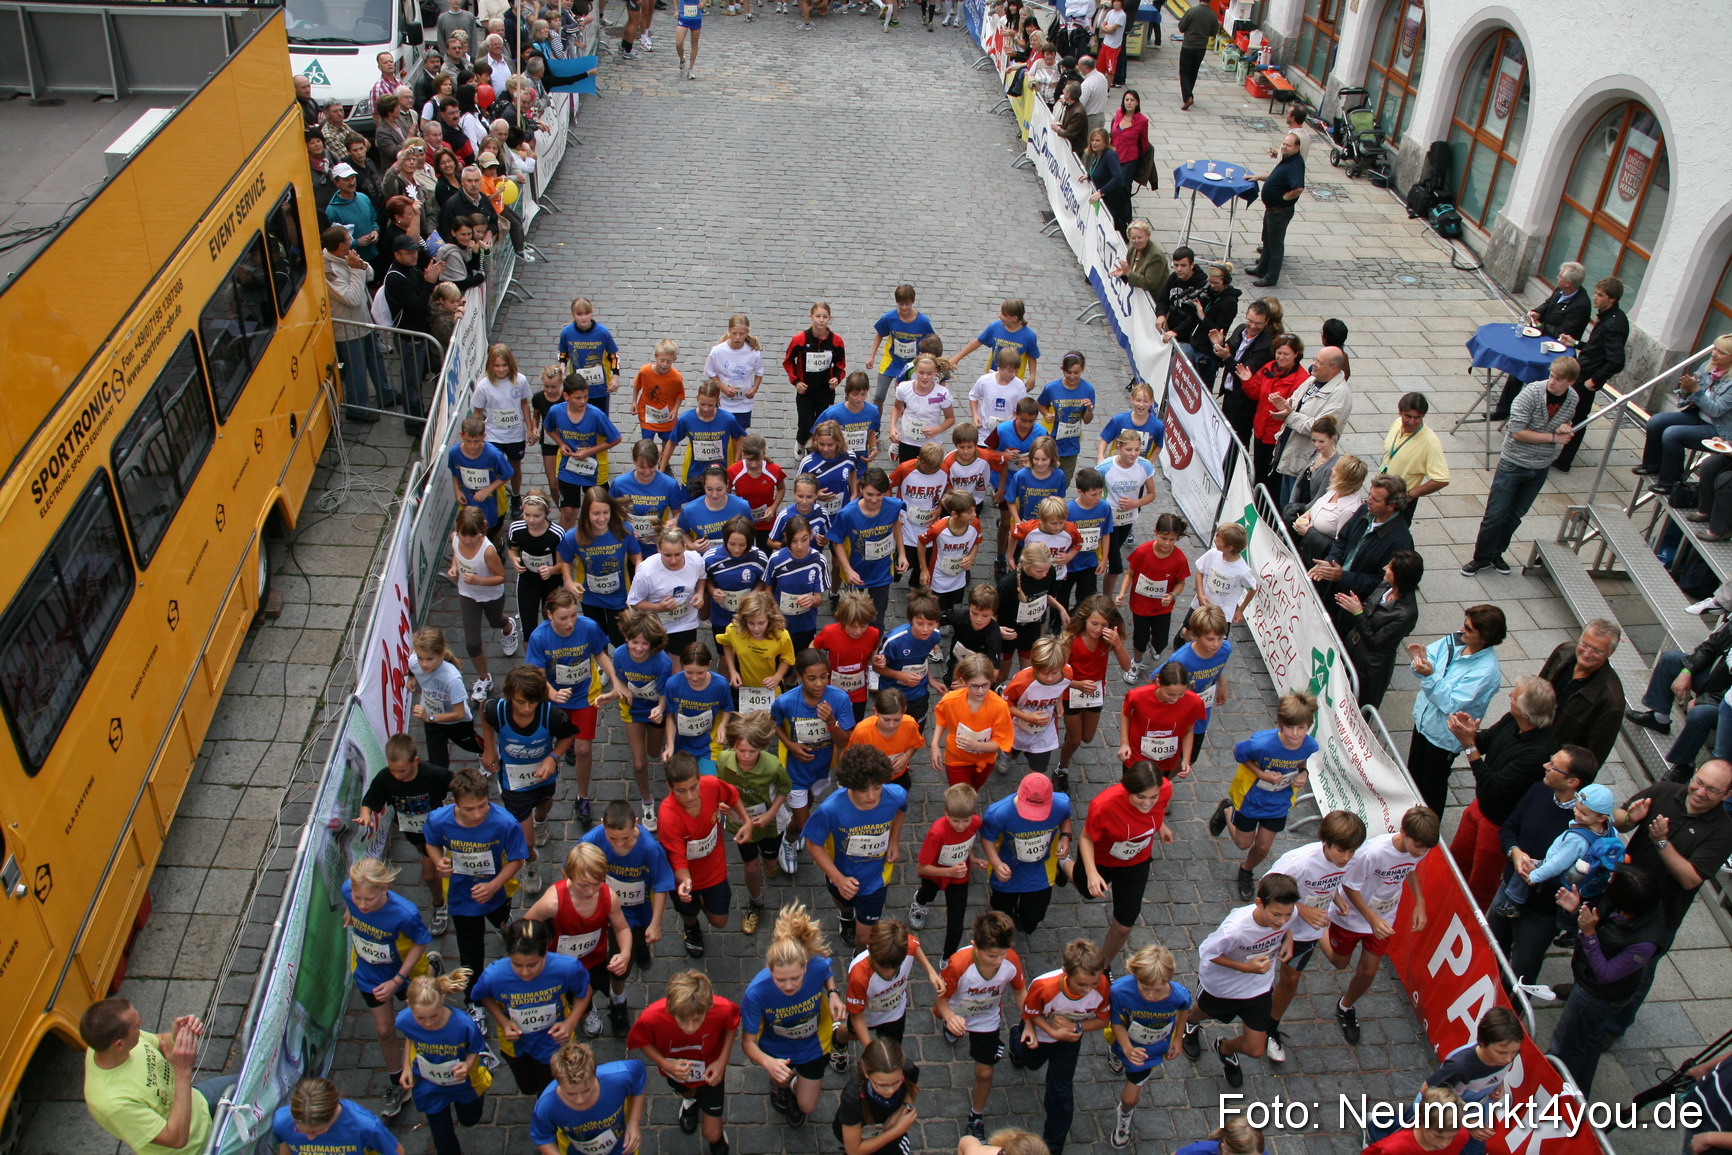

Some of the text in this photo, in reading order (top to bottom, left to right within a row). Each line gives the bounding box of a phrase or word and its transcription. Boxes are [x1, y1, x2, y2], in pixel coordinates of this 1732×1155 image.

[1628, 154, 1646, 171] IMMER
[1622, 171, 1640, 189] NEU
[1619, 182, 1636, 197] MARKT
[209, 172, 266, 262] EVENT SERVICE
[126, 304, 182, 387] www.sportronic-gbr.de
[121, 350, 135, 371] Fon:
[1176, 358, 1199, 398] Wir verkaufen
[500, 415, 518, 424] 4086
[1166, 412, 1188, 456] Wir verkaufen
[31, 381, 112, 505] SPORTRONIC
[39, 405, 115, 519] ELECTRONIC SPORTS EQUIPMENT
[468, 476, 487, 484] 4108
[906, 484, 942, 494] MERZ
[824, 500, 842, 509] 4125
[1116, 512, 1133, 520] 4075
[585, 544, 622, 552] NEUMARKTER
[596, 580, 618, 588] 4032
[1212, 578, 1231, 590] 4013
[1284, 565, 1306, 610] UNS
[668, 606, 688, 616] 4015
[1028, 604, 1046, 616] 4094
[1257, 585, 1297, 665] EINFACH
[552, 644, 589, 654] NEUMARKTER
[1253, 605, 1286, 688] BESSER
[130, 644, 159, 701] RADIO-SYSTEMS
[566, 668, 588, 680] 4164
[750, 696, 772, 704] 4051
[688, 719, 710, 730] 4162
[1152, 746, 1174, 754] 4038
[65, 775, 95, 836] ELA-SYSTEME
[451, 840, 500, 848] NEUMARKTER
[860, 840, 886, 850] 4105
[1024, 838, 1042, 846] Pascal
[463, 860, 490, 868] 4046
[615, 890, 642, 898] 4157
[351, 916, 392, 937] NEUMARKTER
[570, 939, 596, 952] 4160
[362, 946, 387, 960] 4020
[511, 984, 562, 1000] NEUMARKTER
[510, 994, 552, 1006] STADTLAUF
[776, 992, 822, 1013] NEUMARKTER
[520, 1009, 538, 1017] Feyra
[775, 1004, 816, 1020] STADTLAUF
[968, 1004, 993, 1012] 4063
[1131, 1010, 1178, 1018] NEUMARKTER
[522, 1014, 552, 1026] 4047
[786, 1024, 814, 1036] 4030
[418, 1042, 466, 1050] NEUMARKTER
[300, 1144, 358, 1152] NEUMARKTER
